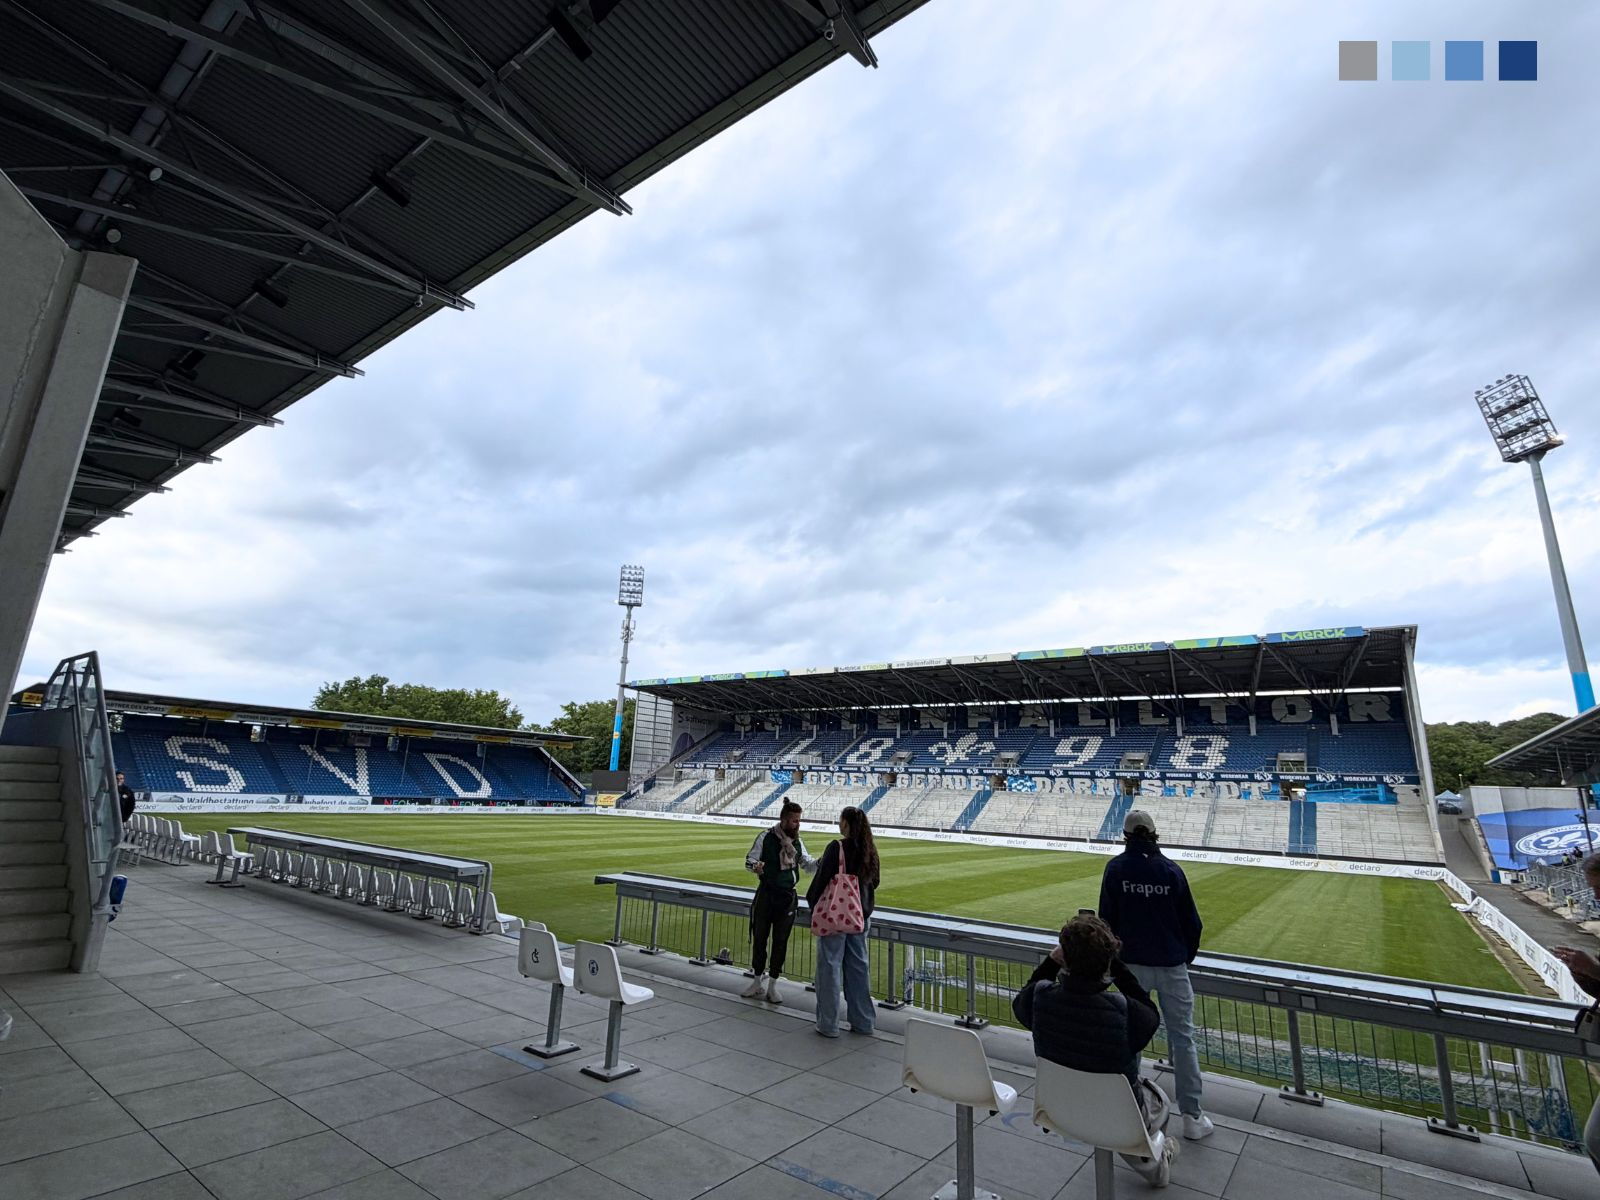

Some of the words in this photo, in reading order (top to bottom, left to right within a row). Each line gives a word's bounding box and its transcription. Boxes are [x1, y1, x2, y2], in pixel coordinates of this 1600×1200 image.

[806, 771, 881, 787] GEGEN
[1349, 863, 1381, 872] declaro
[1122, 880, 1171, 897] Frapor
